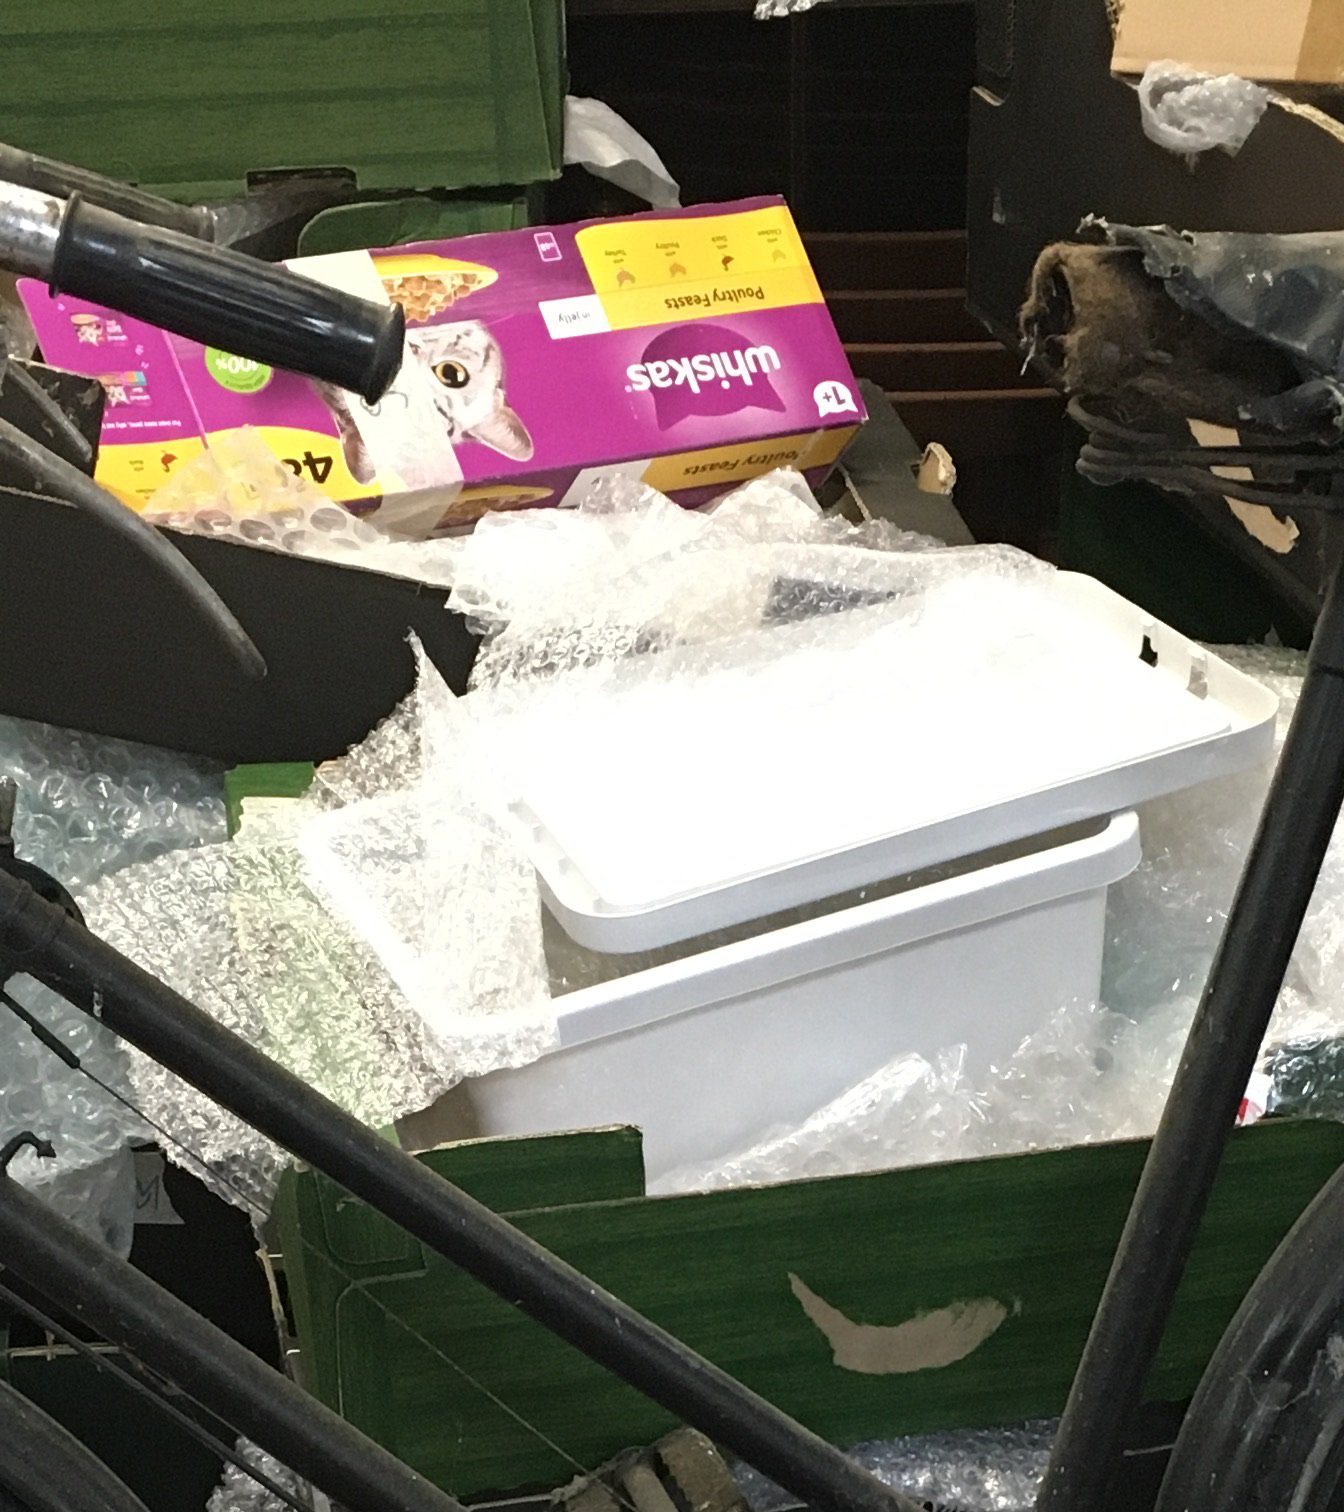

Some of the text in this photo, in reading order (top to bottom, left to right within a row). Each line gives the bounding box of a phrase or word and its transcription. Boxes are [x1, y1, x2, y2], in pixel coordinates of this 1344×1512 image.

[664, 286, 765, 310] Poultry Feasts
[558, 311, 591, 324] in jelly
[626, 345, 781, 394] whiskas
[822, 386, 846, 406] 1+
[682, 459, 741, 477] Feasts
